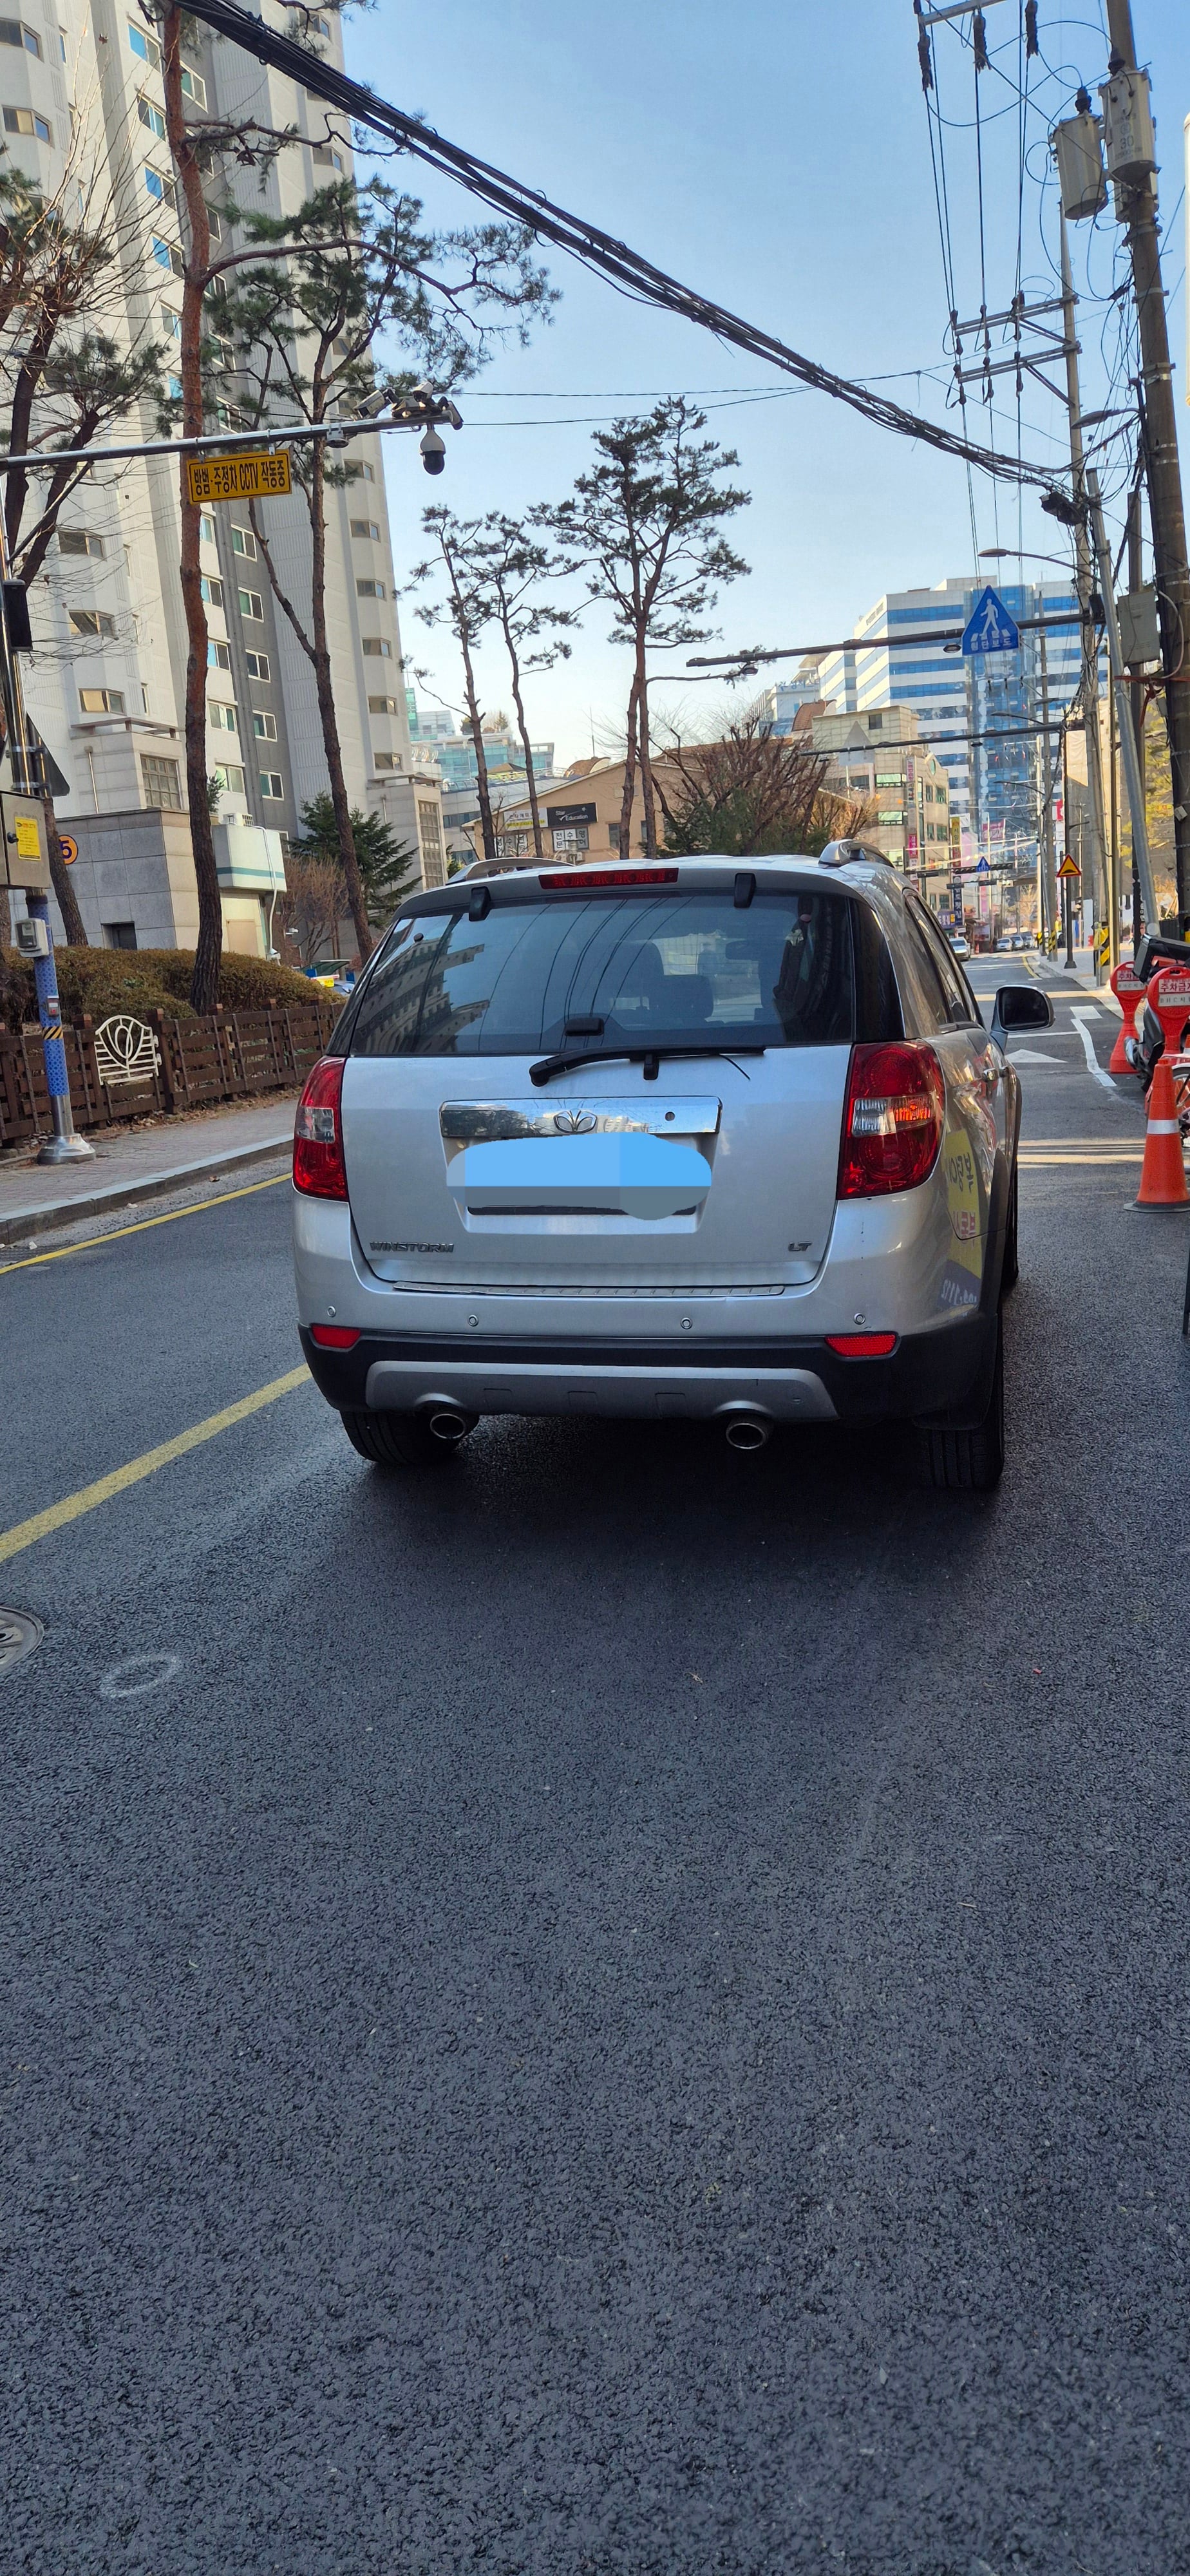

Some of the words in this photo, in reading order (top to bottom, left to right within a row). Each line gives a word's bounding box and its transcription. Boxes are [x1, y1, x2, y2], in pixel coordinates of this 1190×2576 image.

[239, 462, 258, 491] CCTV
[260, 460, 286, 488] 작동중
[369, 1241, 454, 1253] WINSTORM
[788, 1241, 813, 1251] LT
